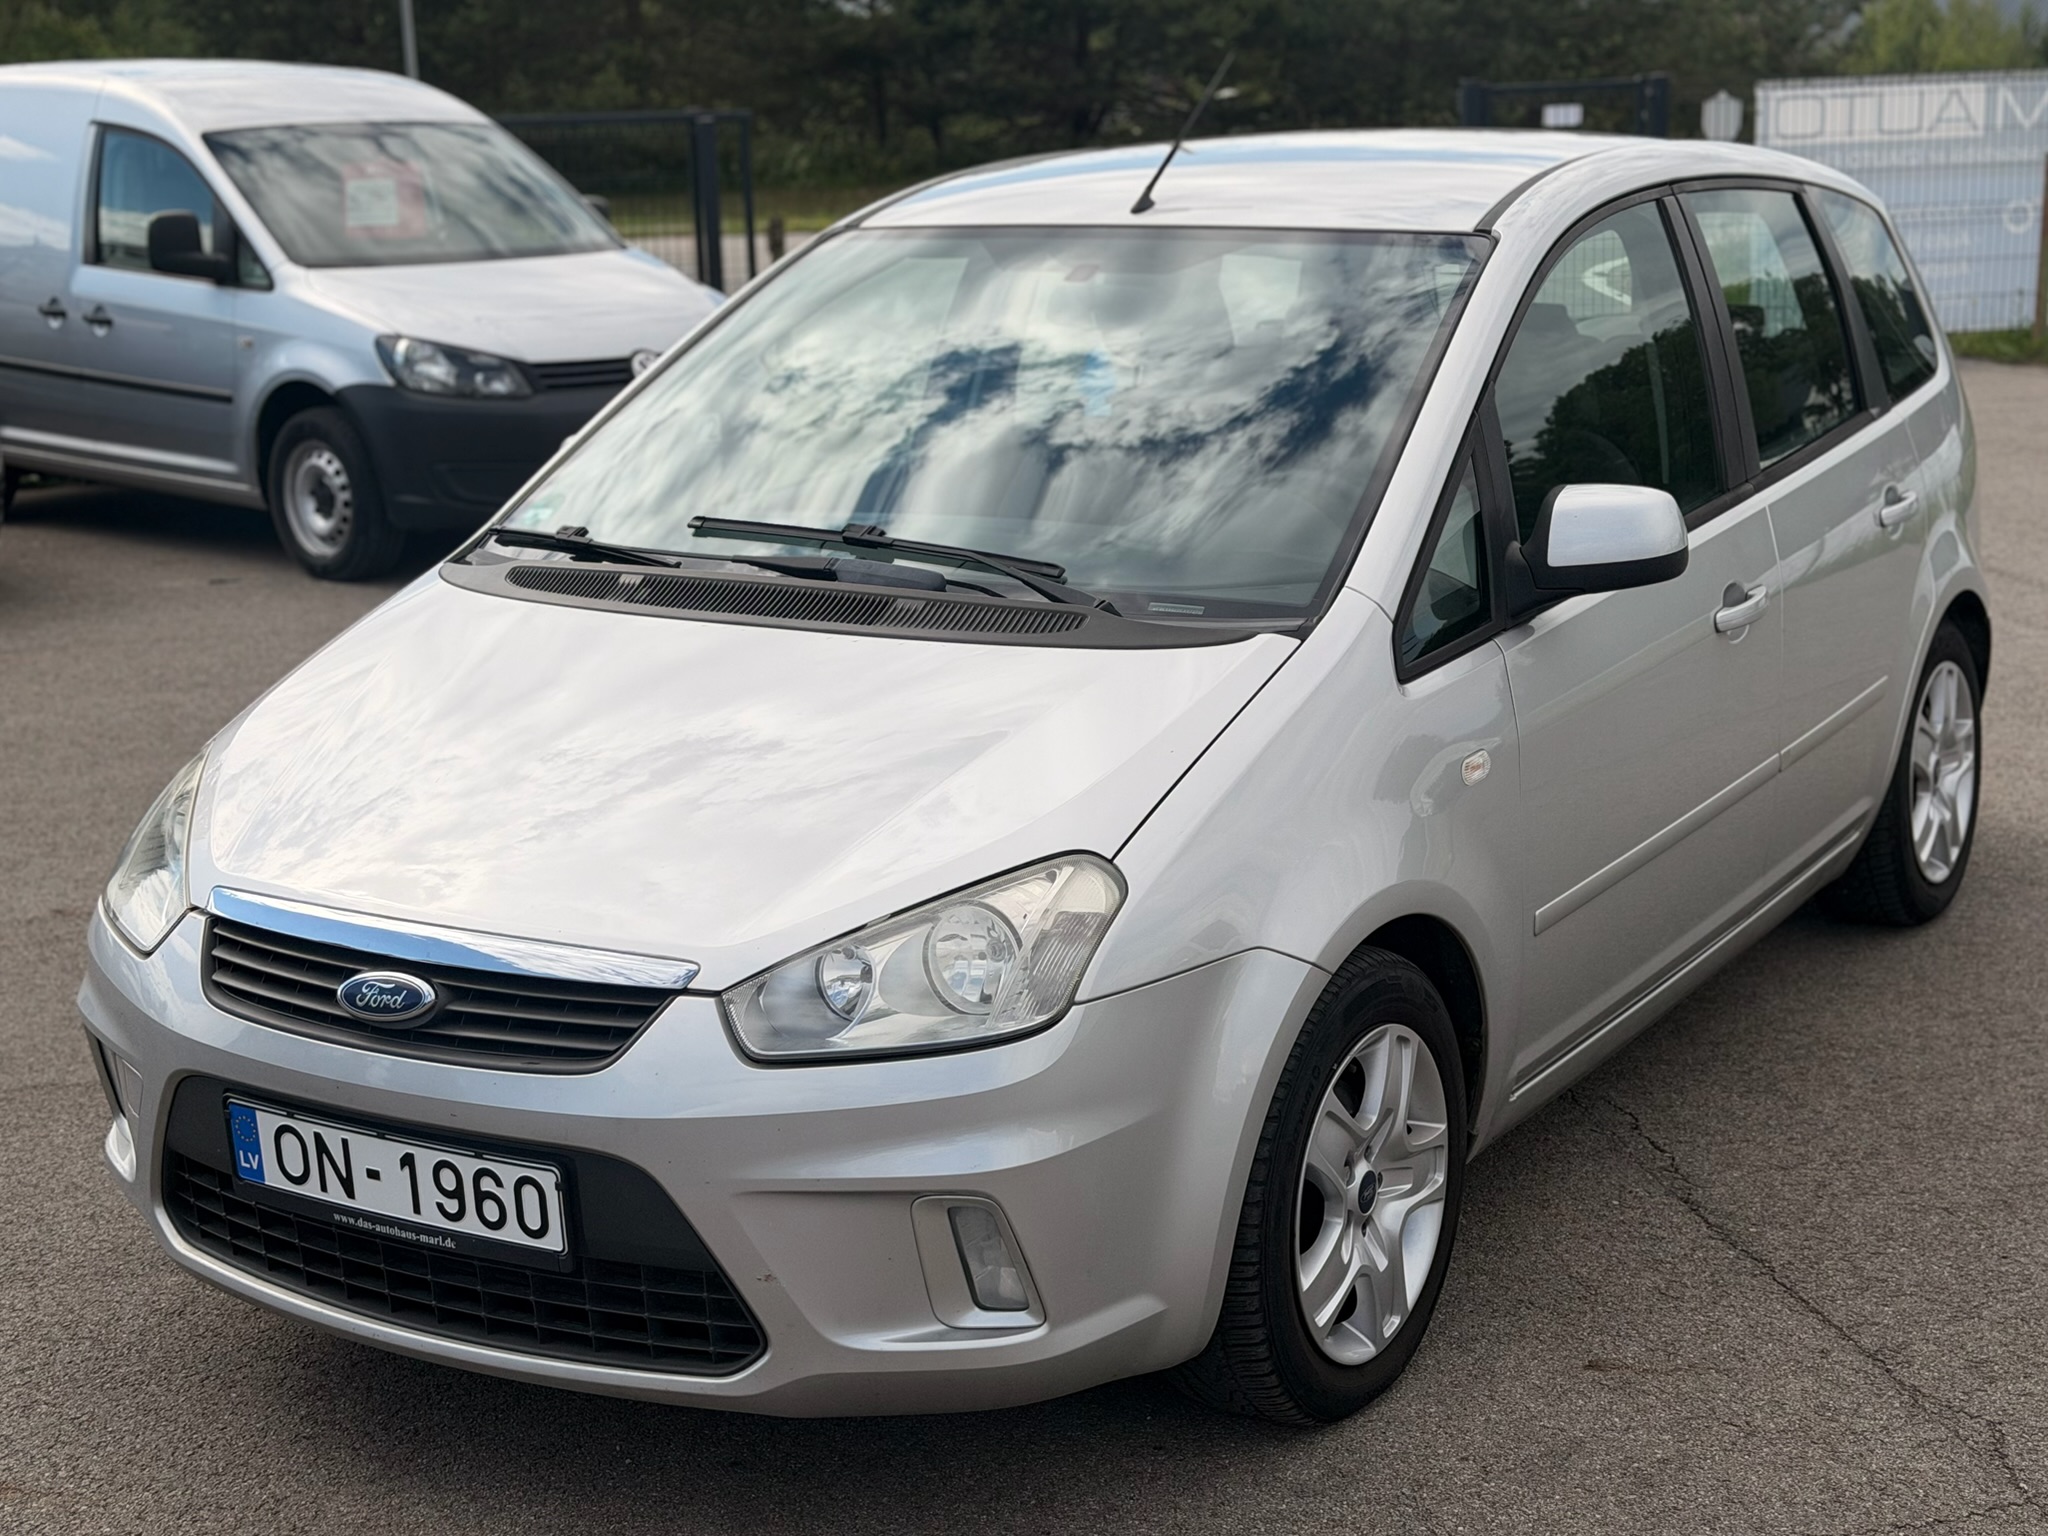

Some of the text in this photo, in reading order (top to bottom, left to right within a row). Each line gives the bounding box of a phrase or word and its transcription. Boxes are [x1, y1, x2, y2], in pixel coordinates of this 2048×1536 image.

[355, 981, 408, 1010] Ford
[239, 1149, 260, 1171] LV
[274, 1123, 550, 1240] ON-1960
[333, 1212, 457, 1249] www.das-autohaus-marl.de
